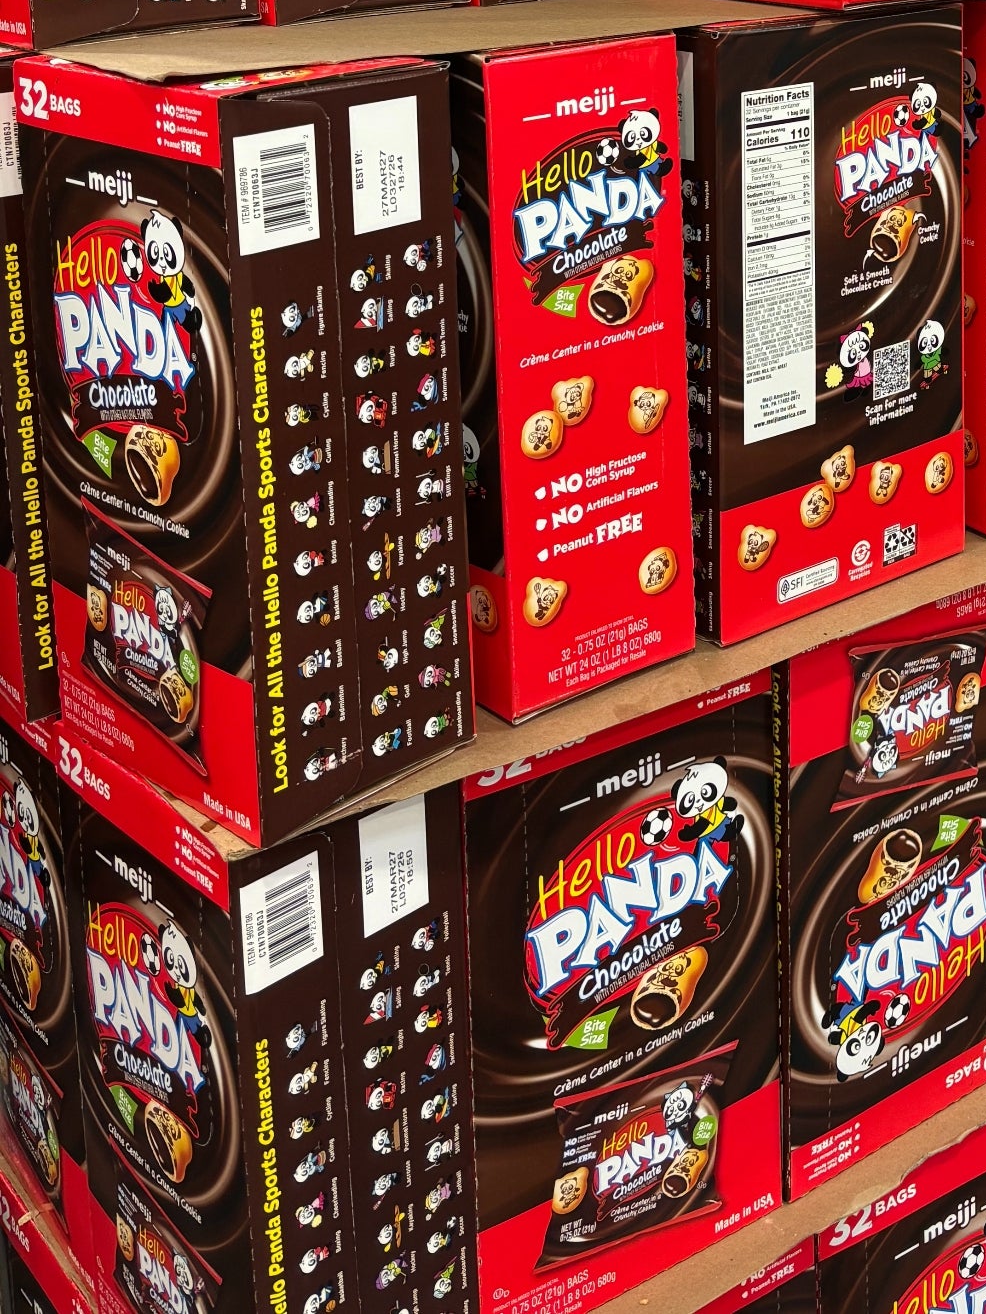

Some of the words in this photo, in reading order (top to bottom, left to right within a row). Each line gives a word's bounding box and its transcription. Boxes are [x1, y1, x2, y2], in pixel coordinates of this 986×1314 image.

[19, 77, 50, 121] 32
[50, 98, 81, 118] BAGS
[555, 87, 616, 121] meiji
[746, 95, 784, 107] Nutrition
[786, 89, 810, 101] Facts
[355, 149, 363, 168] BY:
[746, 135, 779, 147] Calories
[790, 127, 810, 140] 110
[239, 167, 248, 194] 969786
[356, 169, 364, 190] BEST
[380, 150, 390, 217] 27MAR27
[387, 154, 398, 213] L032726
[520, 149, 594, 205] Hello
[835, 122, 941, 205] PANDA
[88, 169, 134, 206] meiji
[252, 168, 261, 219] CTN70063J
[860, 176, 915, 214] Chocolate
[242, 203, 251, 224] ITEM
[514, 170, 665, 265] PANDA
[55, 236, 118, 294] Hello
[553, 224, 629, 276] Chocolate
[555, 289, 576, 303] Bite
[841, 281, 872, 297] Chocolate
[873, 276, 893, 289] Crème
[843, 276, 858, 286] Soft
[866, 268, 890, 280] Smooth
[553, 300, 575, 315] Size
[54, 285, 197, 390] PANDA
[519, 351, 550, 370] Crème
[553, 343, 583, 364] Center
[584, 342, 592, 353] in
[594, 340, 600, 350] a
[601, 329, 636, 351] Crunchy
[637, 321, 665, 338] Cookie
[250, 307, 270, 424] Characters
[88, 379, 158, 409] Chocolate
[865, 405, 883, 418] Scan
[884, 400, 896, 410] for
[898, 393, 917, 404] more
[869, 405, 914, 426] information
[255, 427, 276, 499] Sports
[551, 473, 583, 499] NO
[585, 464, 606, 478] High
[608, 451, 647, 470] Fructose
[586, 475, 607, 488] Corn
[610, 465, 635, 481] Syrup
[552, 504, 584, 530] NO
[586, 491, 625, 512] Artificial
[627, 481, 658, 498] Flavors
[259, 502, 278, 569] Panda
[553, 533, 594, 557] Peanut
[595, 511, 642, 545] FREE
[262, 573, 281, 629] Hello
[266, 632, 282, 667] the
[561, 648, 571, 662] 32
[578, 639, 594, 655] 0.75
[596, 633, 606, 647] OZ
[607, 627, 626, 646] (21g)
[628, 617, 648, 635] BAGS
[267, 670, 284, 698] All
[270, 706, 285, 737] for
[271, 738, 289, 794] Look
[596, 752, 662, 798] meiji
[388, 851, 398, 913] 27MAR27
[397, 851, 406, 907] L032726
[536, 831, 637, 912] Hello
[527, 836, 734, 997] PANDA
[579, 919, 683, 1002] Chocolate
[87, 948, 206, 1096] PANDA
[580, 1030, 605, 1047] Size
[582, 1016, 608, 1033] Bite
[890, 1032, 943, 1077] meiji
[944, 1054, 982, 1088] BAGS
